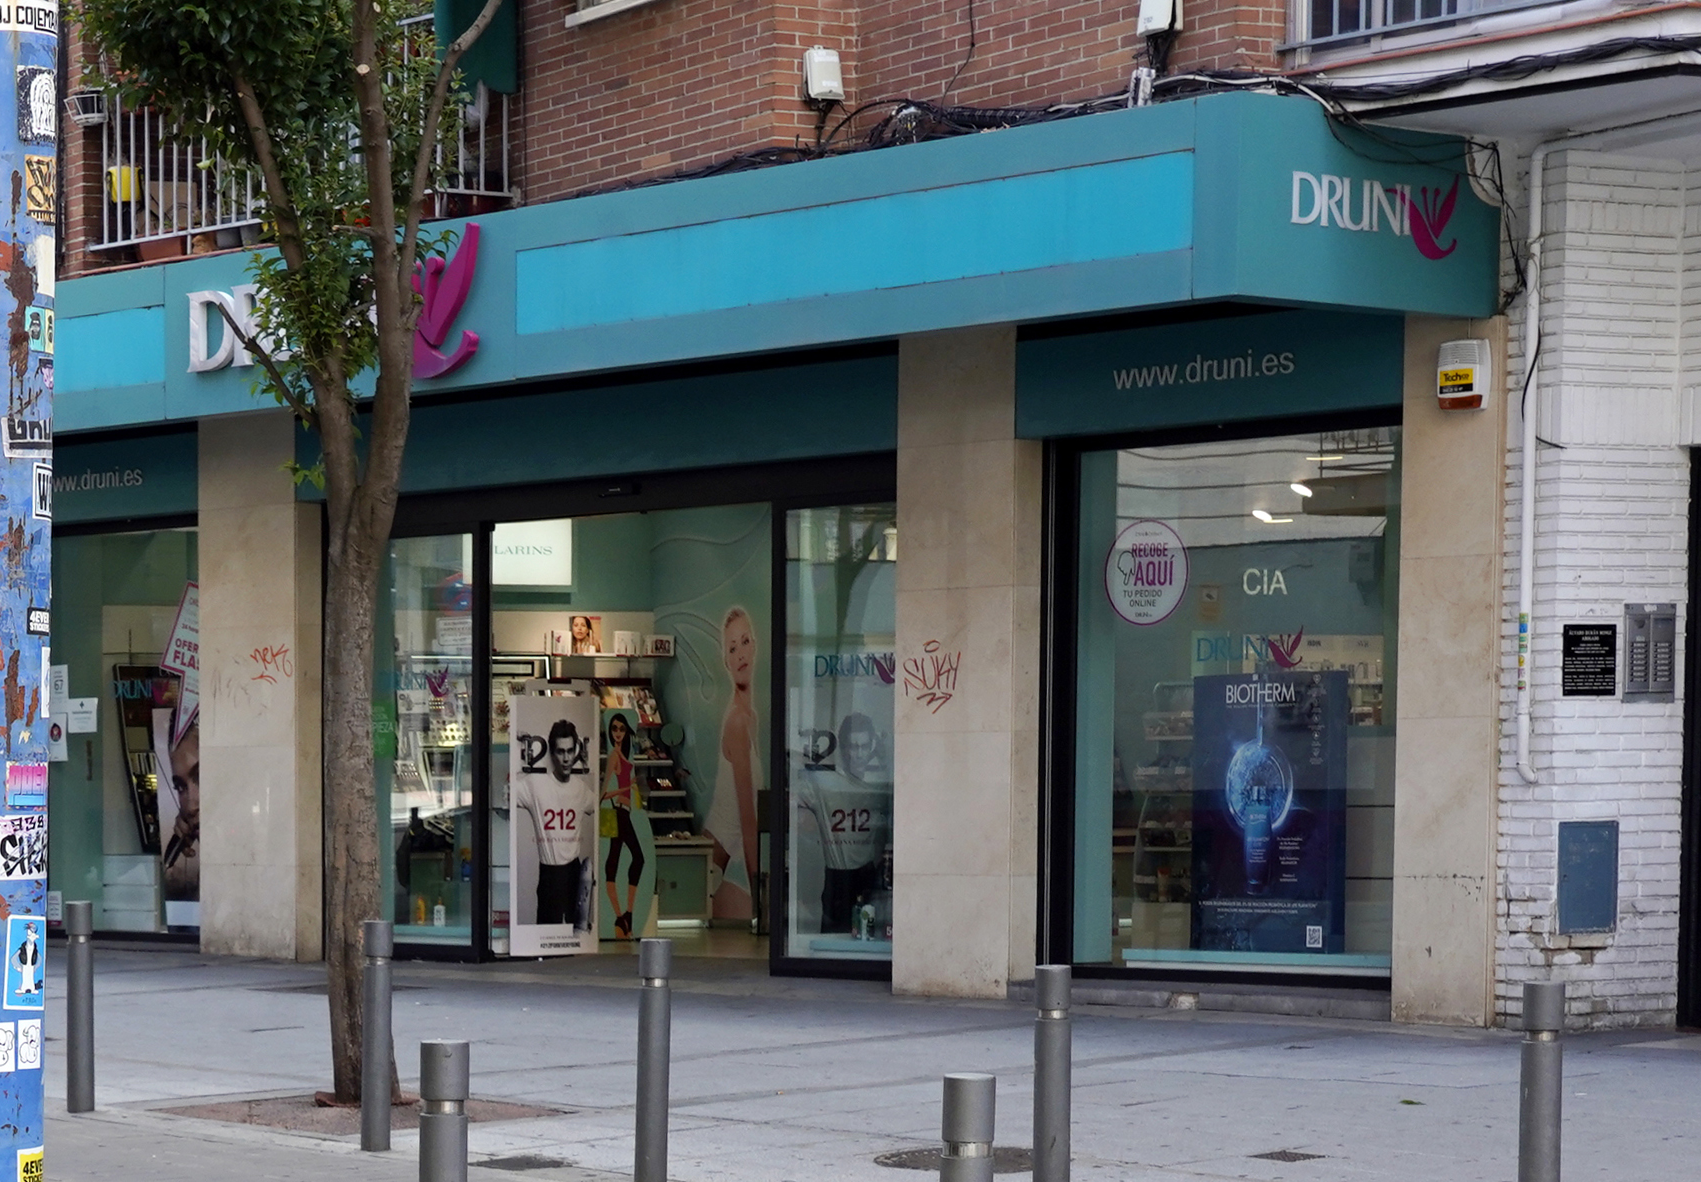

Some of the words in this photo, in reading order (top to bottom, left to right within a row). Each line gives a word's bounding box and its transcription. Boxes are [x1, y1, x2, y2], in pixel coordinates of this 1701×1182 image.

[1290, 171, 1412, 236] DRUNI
[1112, 349, 1295, 390] www.druni.es
[494, 544, 553, 556] LARINS
[1132, 543, 1169, 558] RECOGE
[1133, 554, 1175, 586] AQUÍ
[1123, 589, 1133, 598] TU
[1134, 589, 1162, 598] PEDIDO
[1243, 568, 1288, 596] CIA
[1129, 599, 1156, 607] ONLINE
[175, 638, 199, 654] OFER
[1196, 634, 1270, 662] DRUNI
[814, 654, 876, 678] DRUNI
[1225, 682, 1296, 704] BIOTHERM
[543, 809, 576, 830] 212
[831, 809, 871, 833] 212
